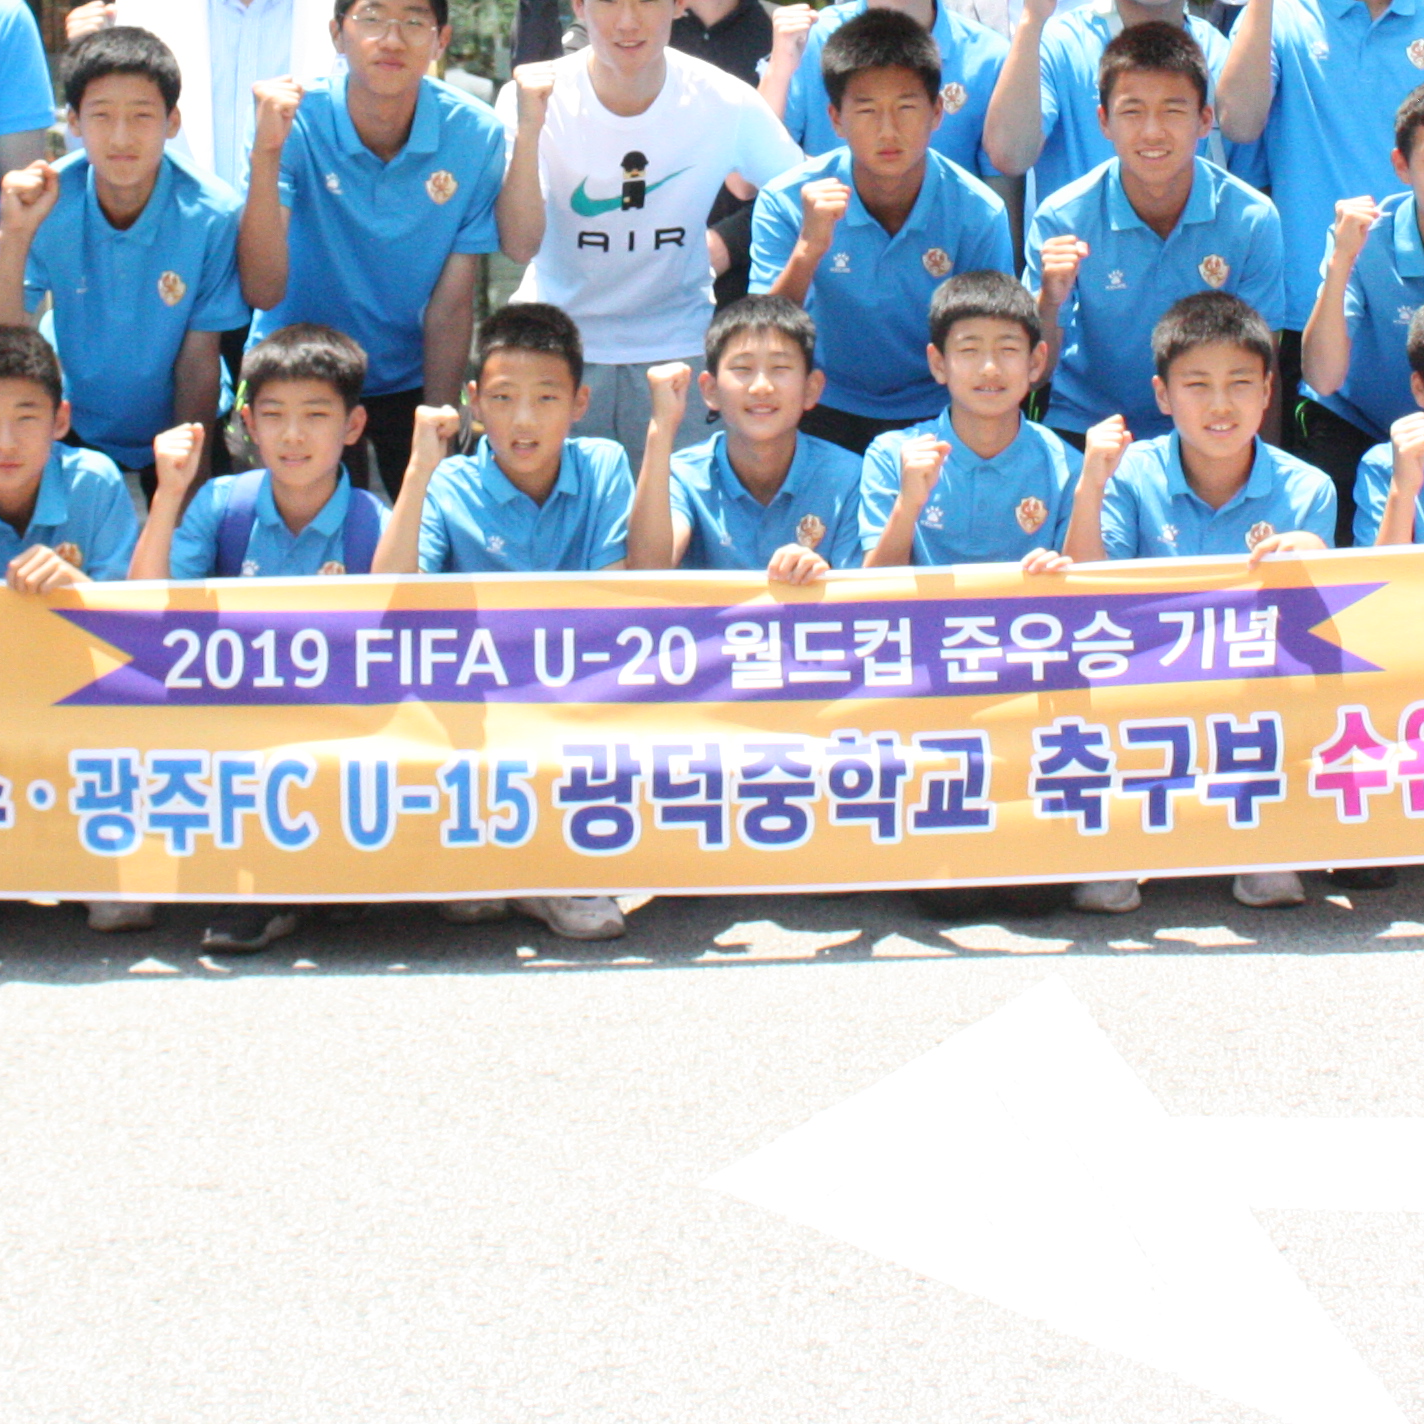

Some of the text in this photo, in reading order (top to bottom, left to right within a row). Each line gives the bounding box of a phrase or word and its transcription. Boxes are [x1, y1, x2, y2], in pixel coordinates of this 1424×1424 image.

[577, 227, 686, 253] AIR
[161, 604, 1281, 691] 2019 FIFA U-20 월드컵 준우승 기념
[346, 760, 533, 850] U-15
[557, 734, 992, 853] 광덕중학교
[1034, 718, 1283, 831] 축구부
